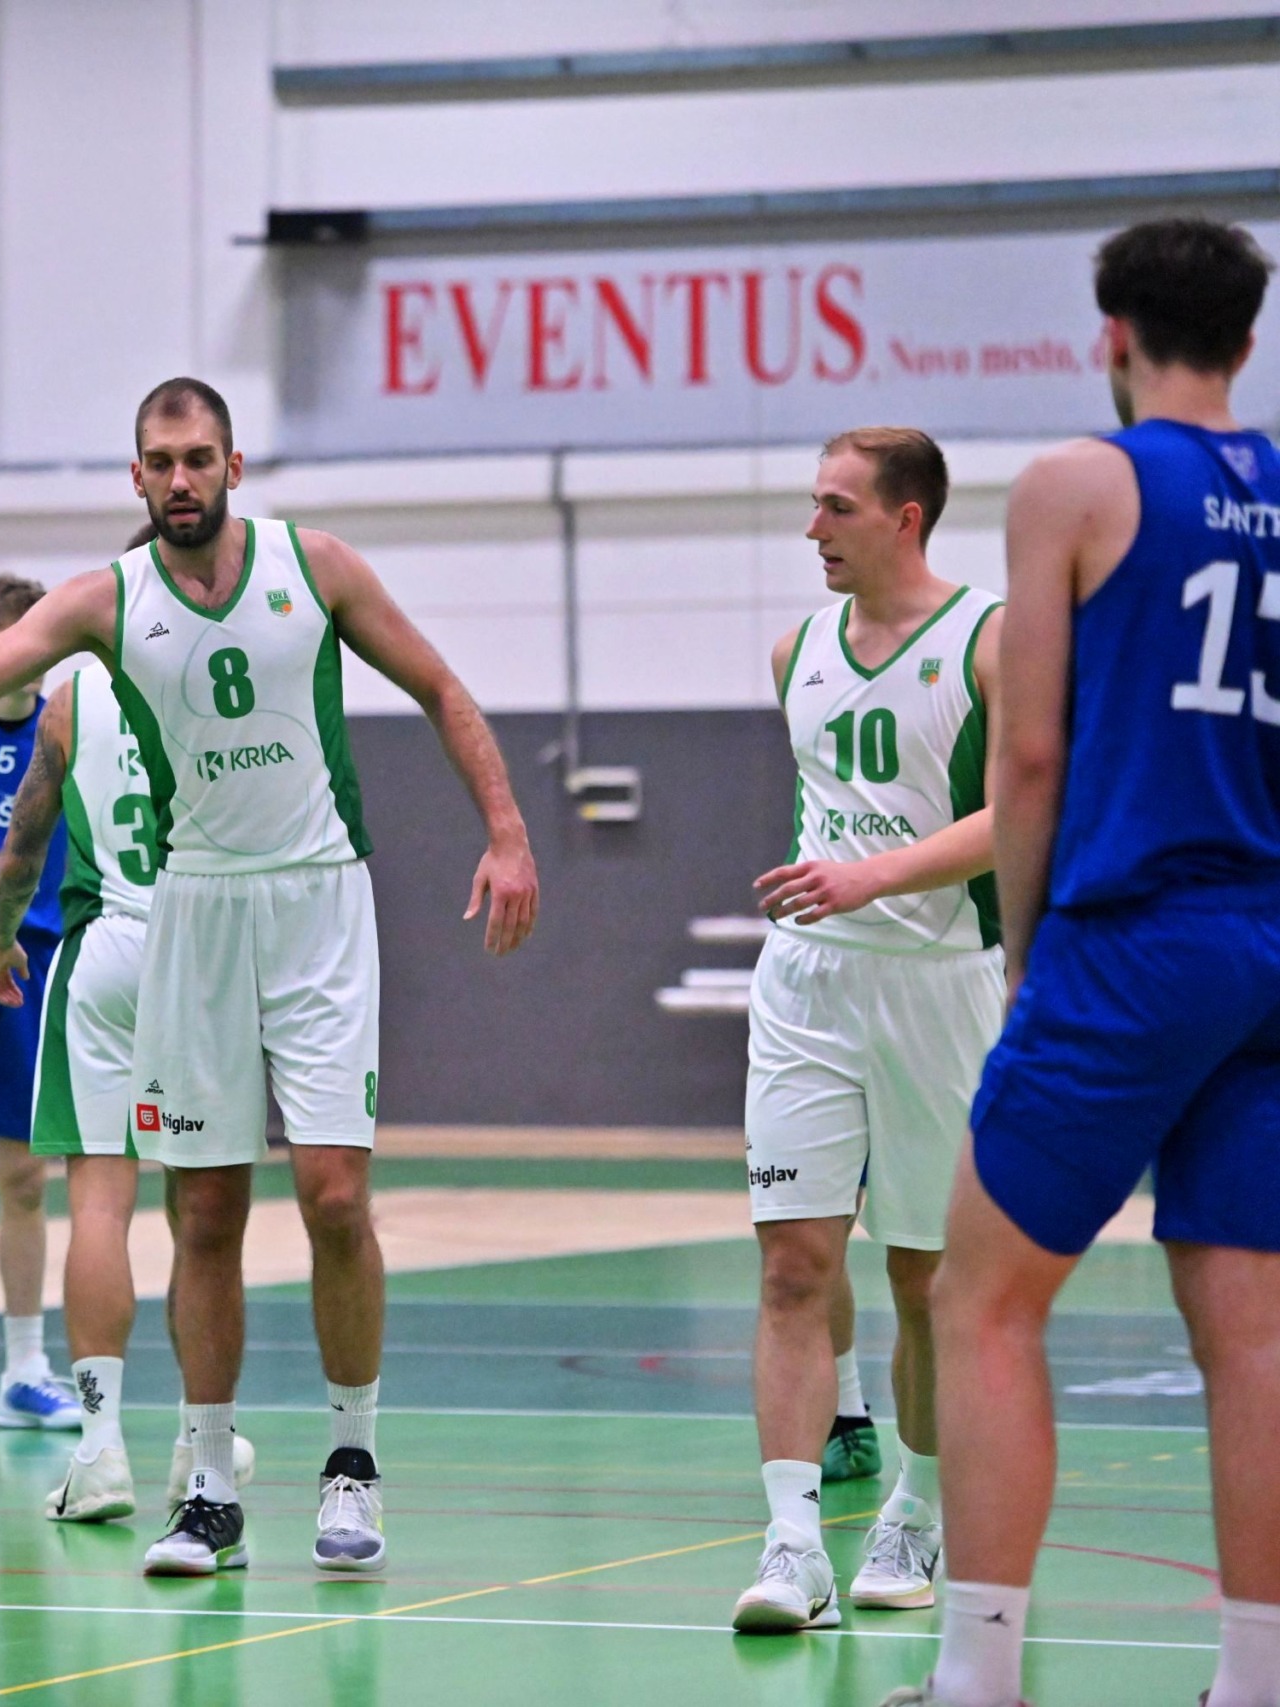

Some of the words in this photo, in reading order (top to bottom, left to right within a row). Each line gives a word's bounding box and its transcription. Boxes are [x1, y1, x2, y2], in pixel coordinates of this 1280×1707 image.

[208, 647, 255, 719] 8
[230, 742, 294, 772] KRKA
[825, 707, 900, 784] 10
[853, 812, 918, 838] KRKA
[365, 1070, 377, 1119] 8
[161, 1111, 205, 1135] triglav
[749, 1165, 798, 1188] triglav
